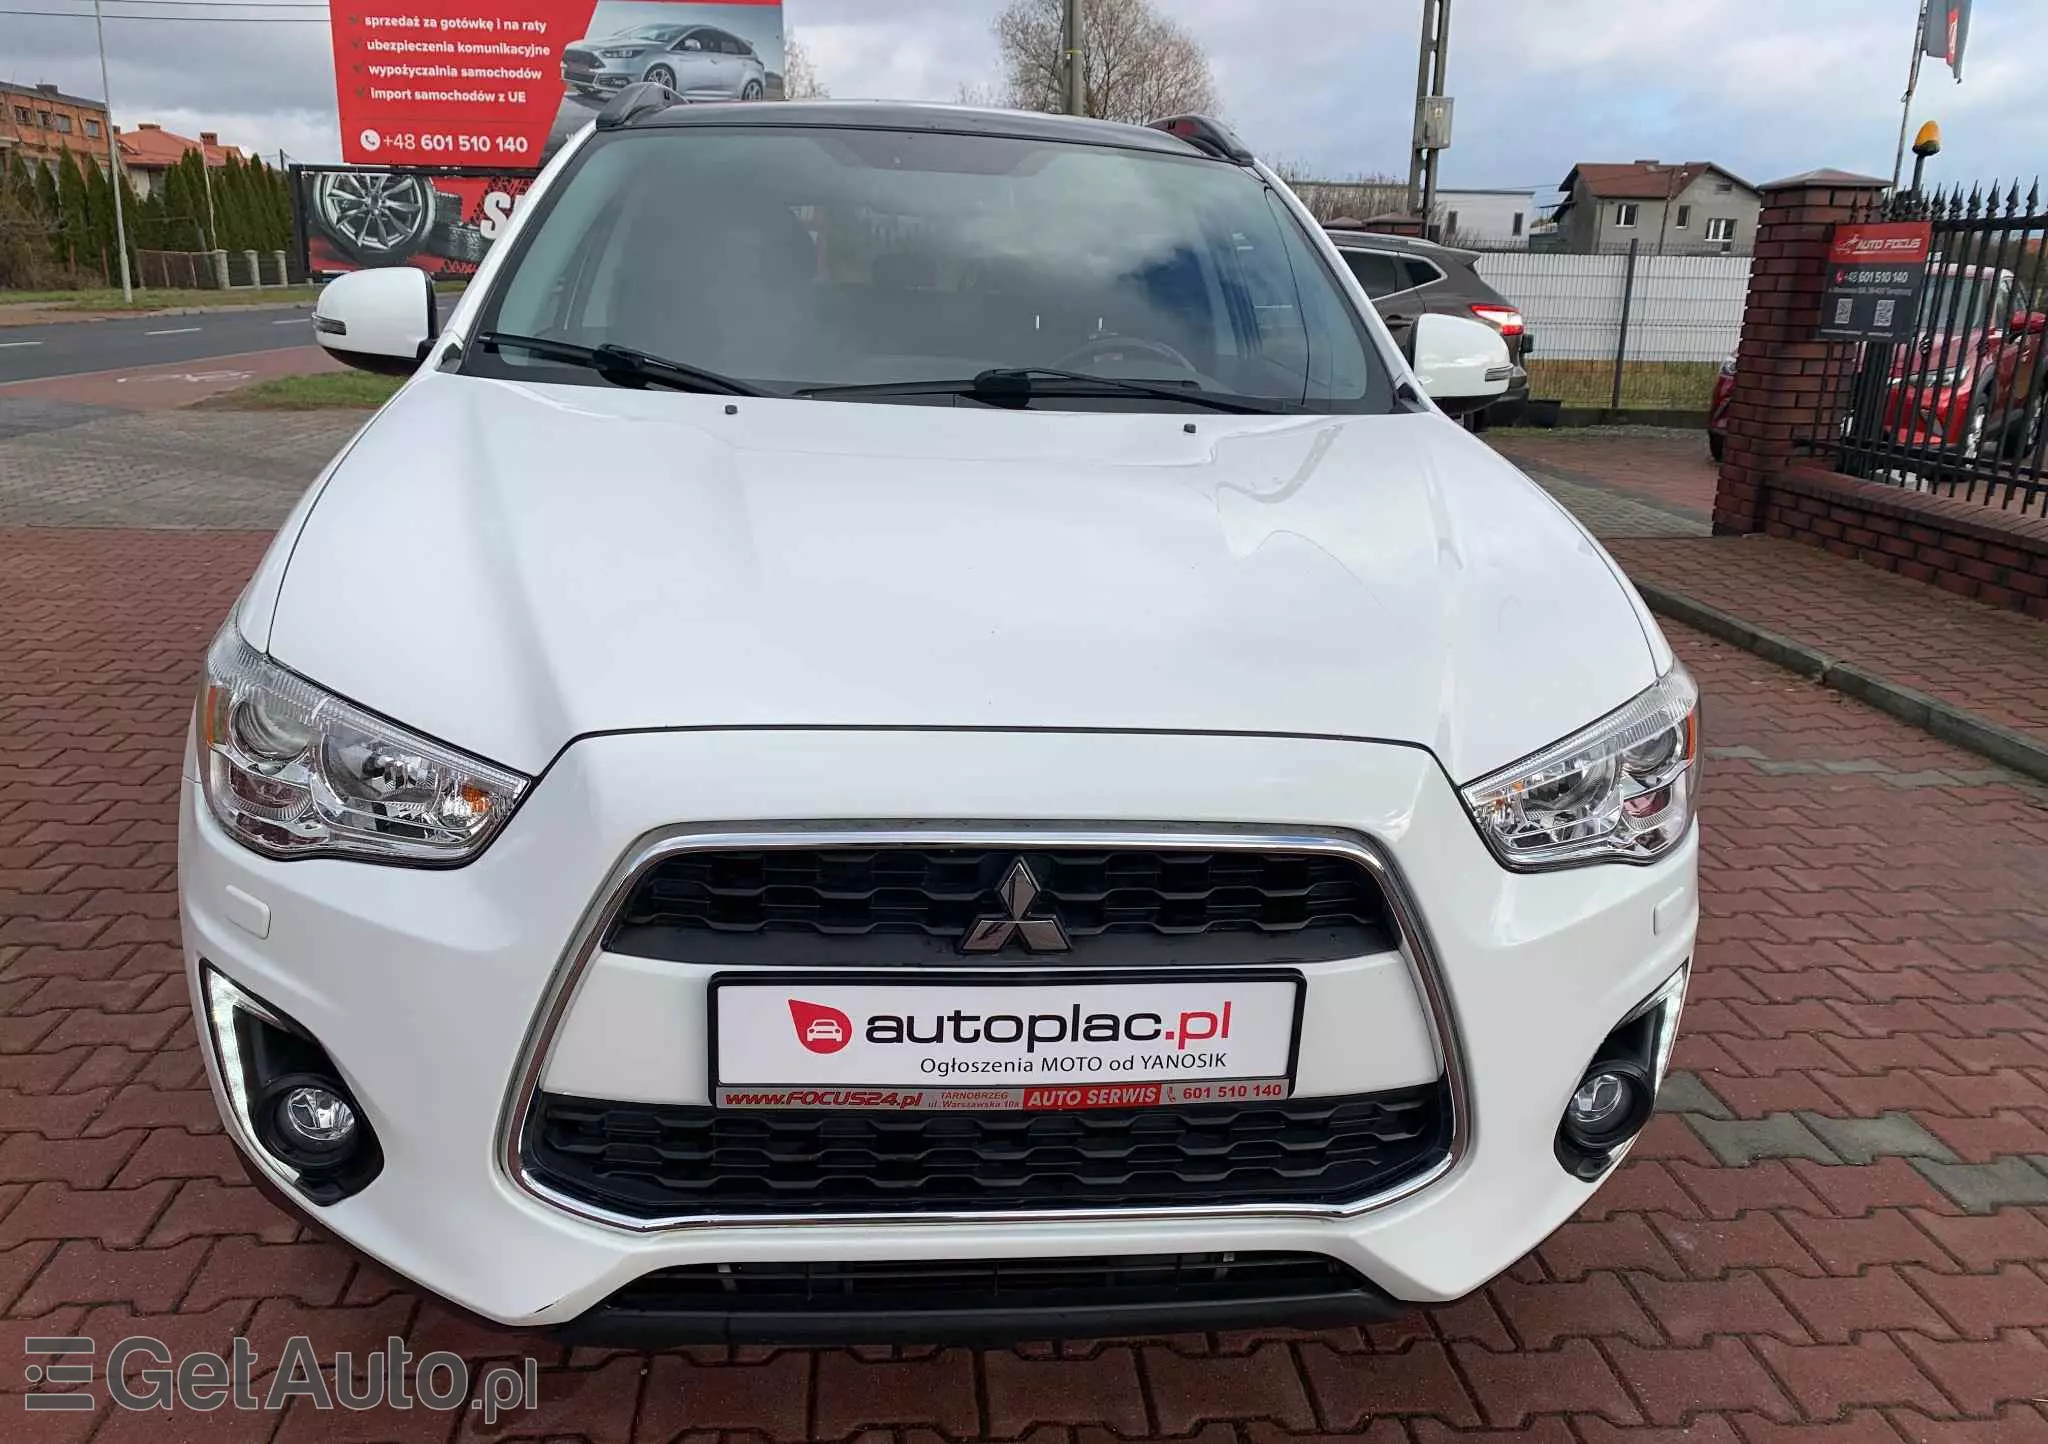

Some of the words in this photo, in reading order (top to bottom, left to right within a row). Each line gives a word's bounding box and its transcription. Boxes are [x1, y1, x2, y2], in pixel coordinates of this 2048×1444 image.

[365, 15, 421, 27] sprzedaż
[423, 18, 438, 28] za
[440, 17, 494, 32] gotówkę
[503, 20, 519, 30] na
[522, 20, 547, 34] raty
[367, 40, 455, 53] ubezpieczenia
[457, 42, 550, 58] komunikacyjne
[368, 64, 458, 78] wypożyczalnia
[461, 66, 542, 80] samochodów
[414, 89, 496, 102] samochodów
[498, 93, 505, 102] z
[507, 91, 527, 103] UE
[384, 134, 415, 150] +48
[421, 135, 454, 151] 601
[458, 136, 490, 152] 510
[495, 137, 528, 153] 140
[1859, 271, 1873, 282] 601
[865, 1001, 1232, 1053] autoplac.pl
[920, 1057, 1034, 1077] Ogłoszenia
[1041, 1056, 1102, 1072] MOTO
[1109, 1055, 1135, 1071] od
[1140, 1052, 1227, 1069] YANOSIK
[725, 1091, 923, 1109] www.FOCUS24.pl
[941, 1091, 1009, 1100] TARNOBRZEG
[1028, 1090, 1081, 1106] AUTO
[1086, 1087, 1156, 1105] SERWIS
[1183, 1087, 1211, 1100] 601
[1218, 1086, 1247, 1098] 510
[1253, 1084, 1282, 1097] 140
[942, 1100, 1001, 1109] Warszawska
